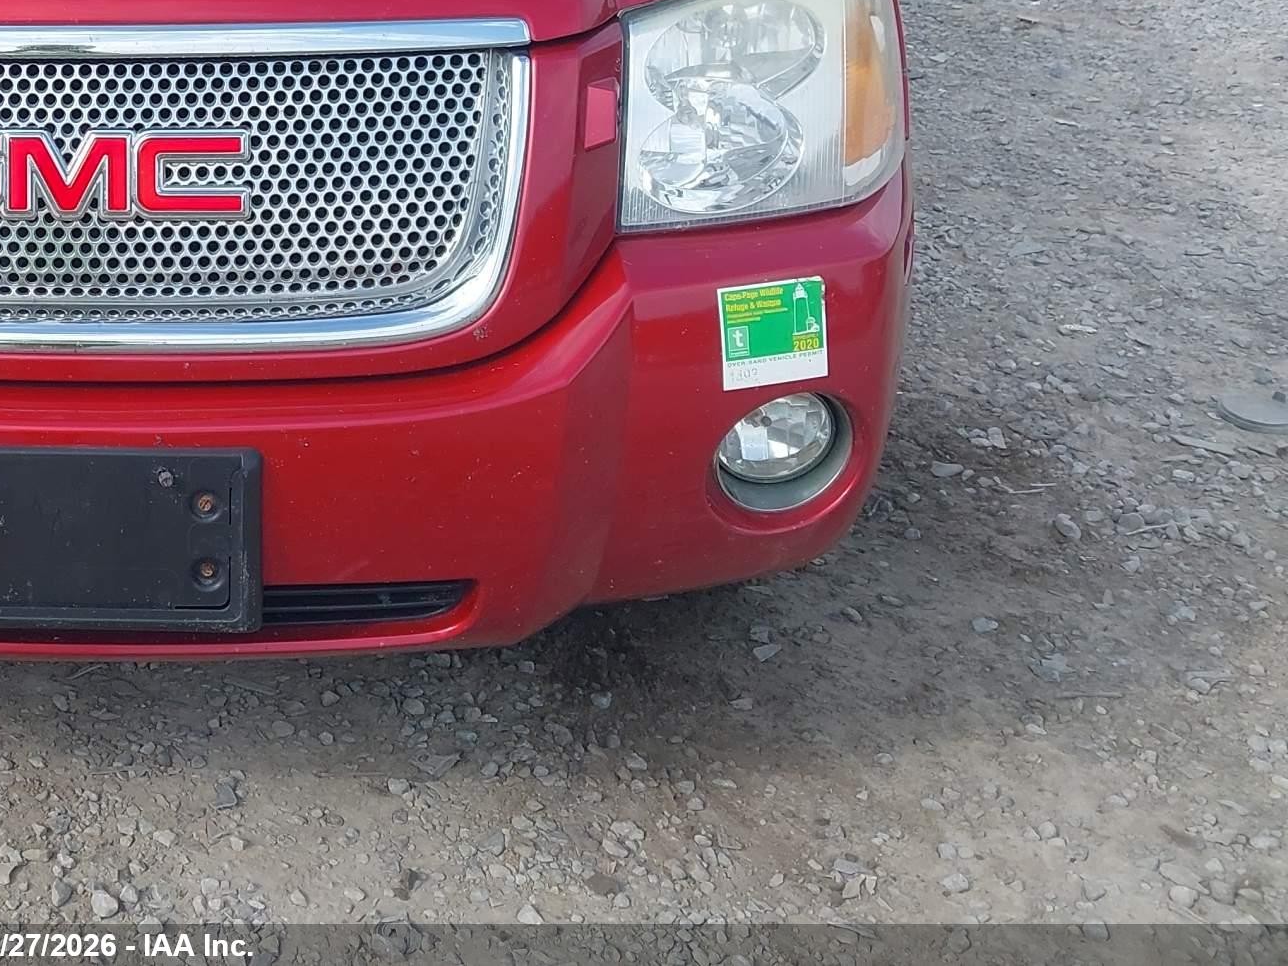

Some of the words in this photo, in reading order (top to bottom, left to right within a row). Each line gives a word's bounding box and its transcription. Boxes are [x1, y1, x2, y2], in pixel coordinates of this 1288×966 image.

[793, 337, 820, 352] 2020
[768, 354, 797, 362] VEHICLE
[798, 350, 823, 358] PERMIT
